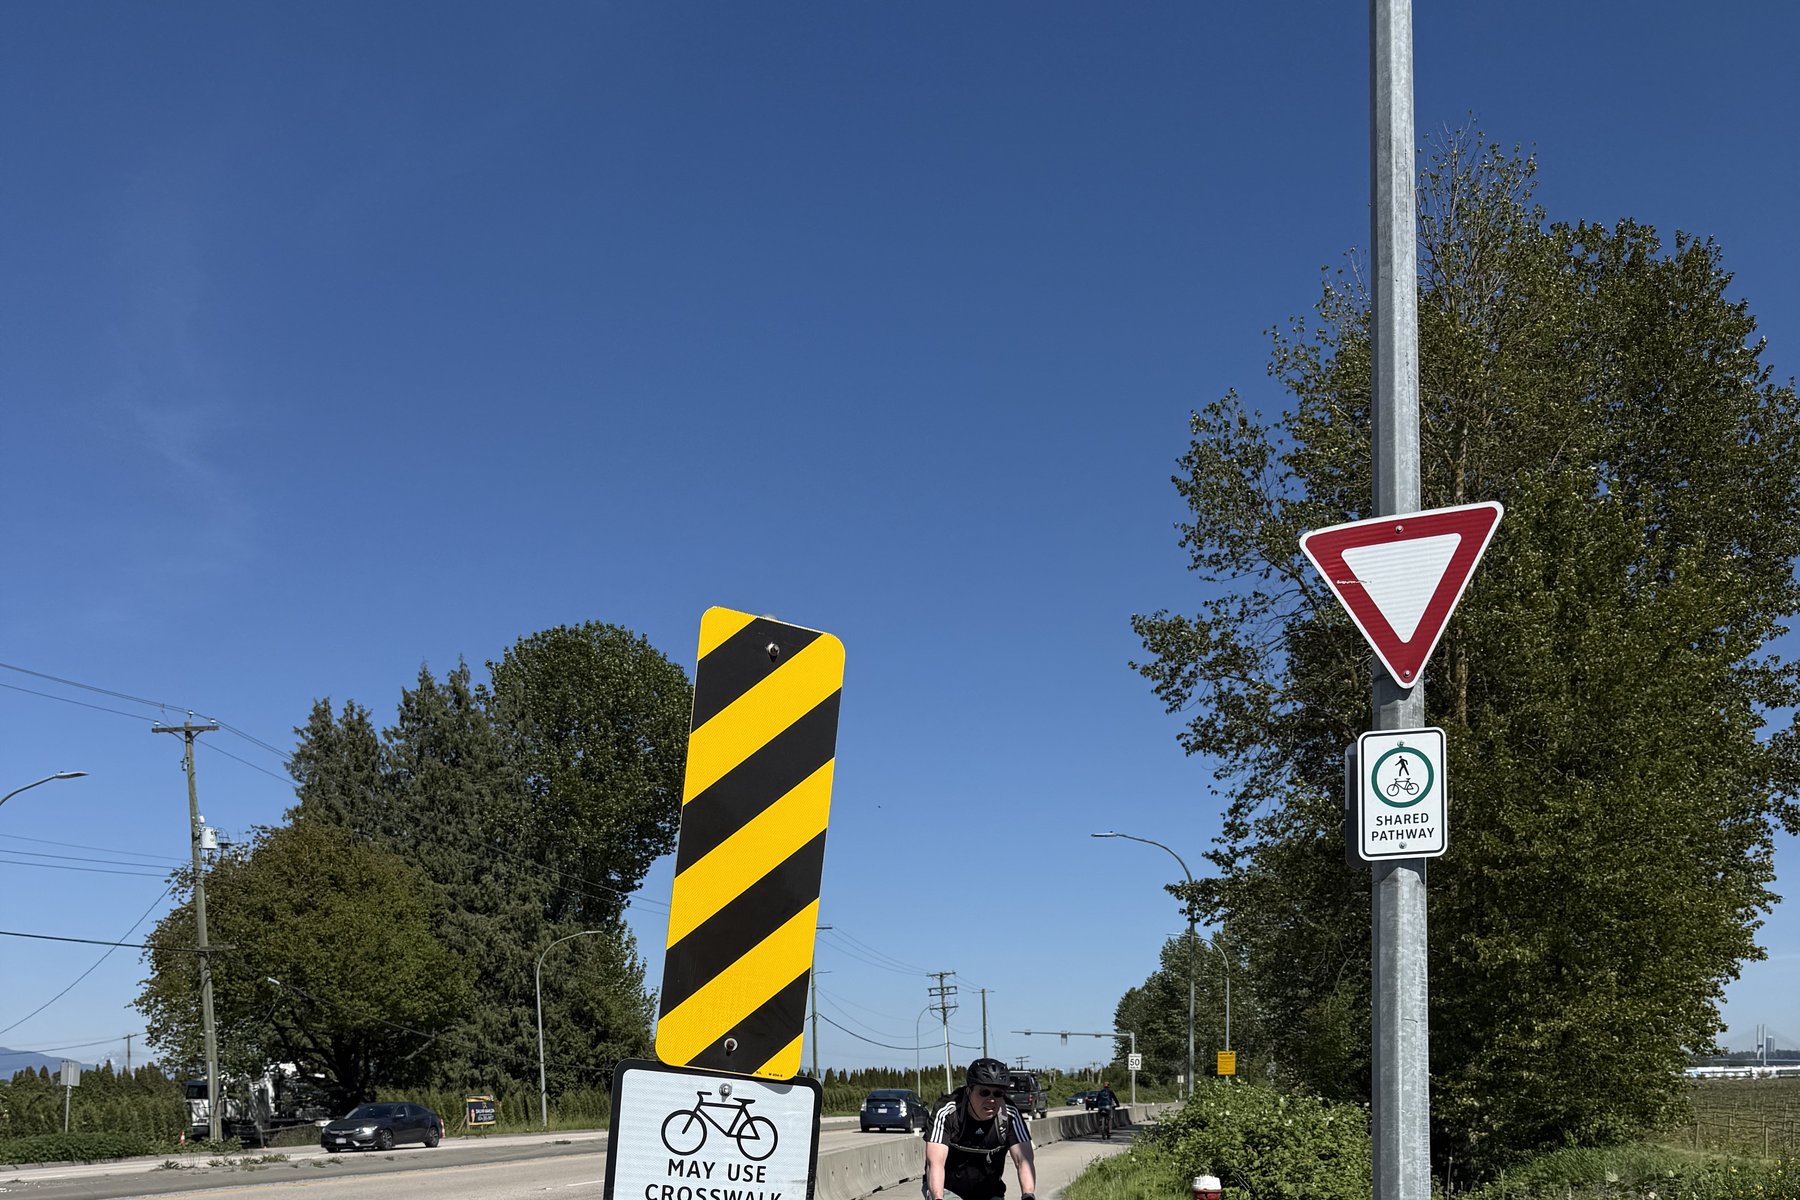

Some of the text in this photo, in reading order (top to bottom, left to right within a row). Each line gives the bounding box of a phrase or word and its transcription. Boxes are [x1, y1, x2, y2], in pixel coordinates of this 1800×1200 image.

[1375, 812, 1430, 827] SHARED
[1371, 827, 1435, 842] PATHWAY
[1130, 1058, 1140, 1066] 50
[667, 1158, 767, 1184] MAY USE
